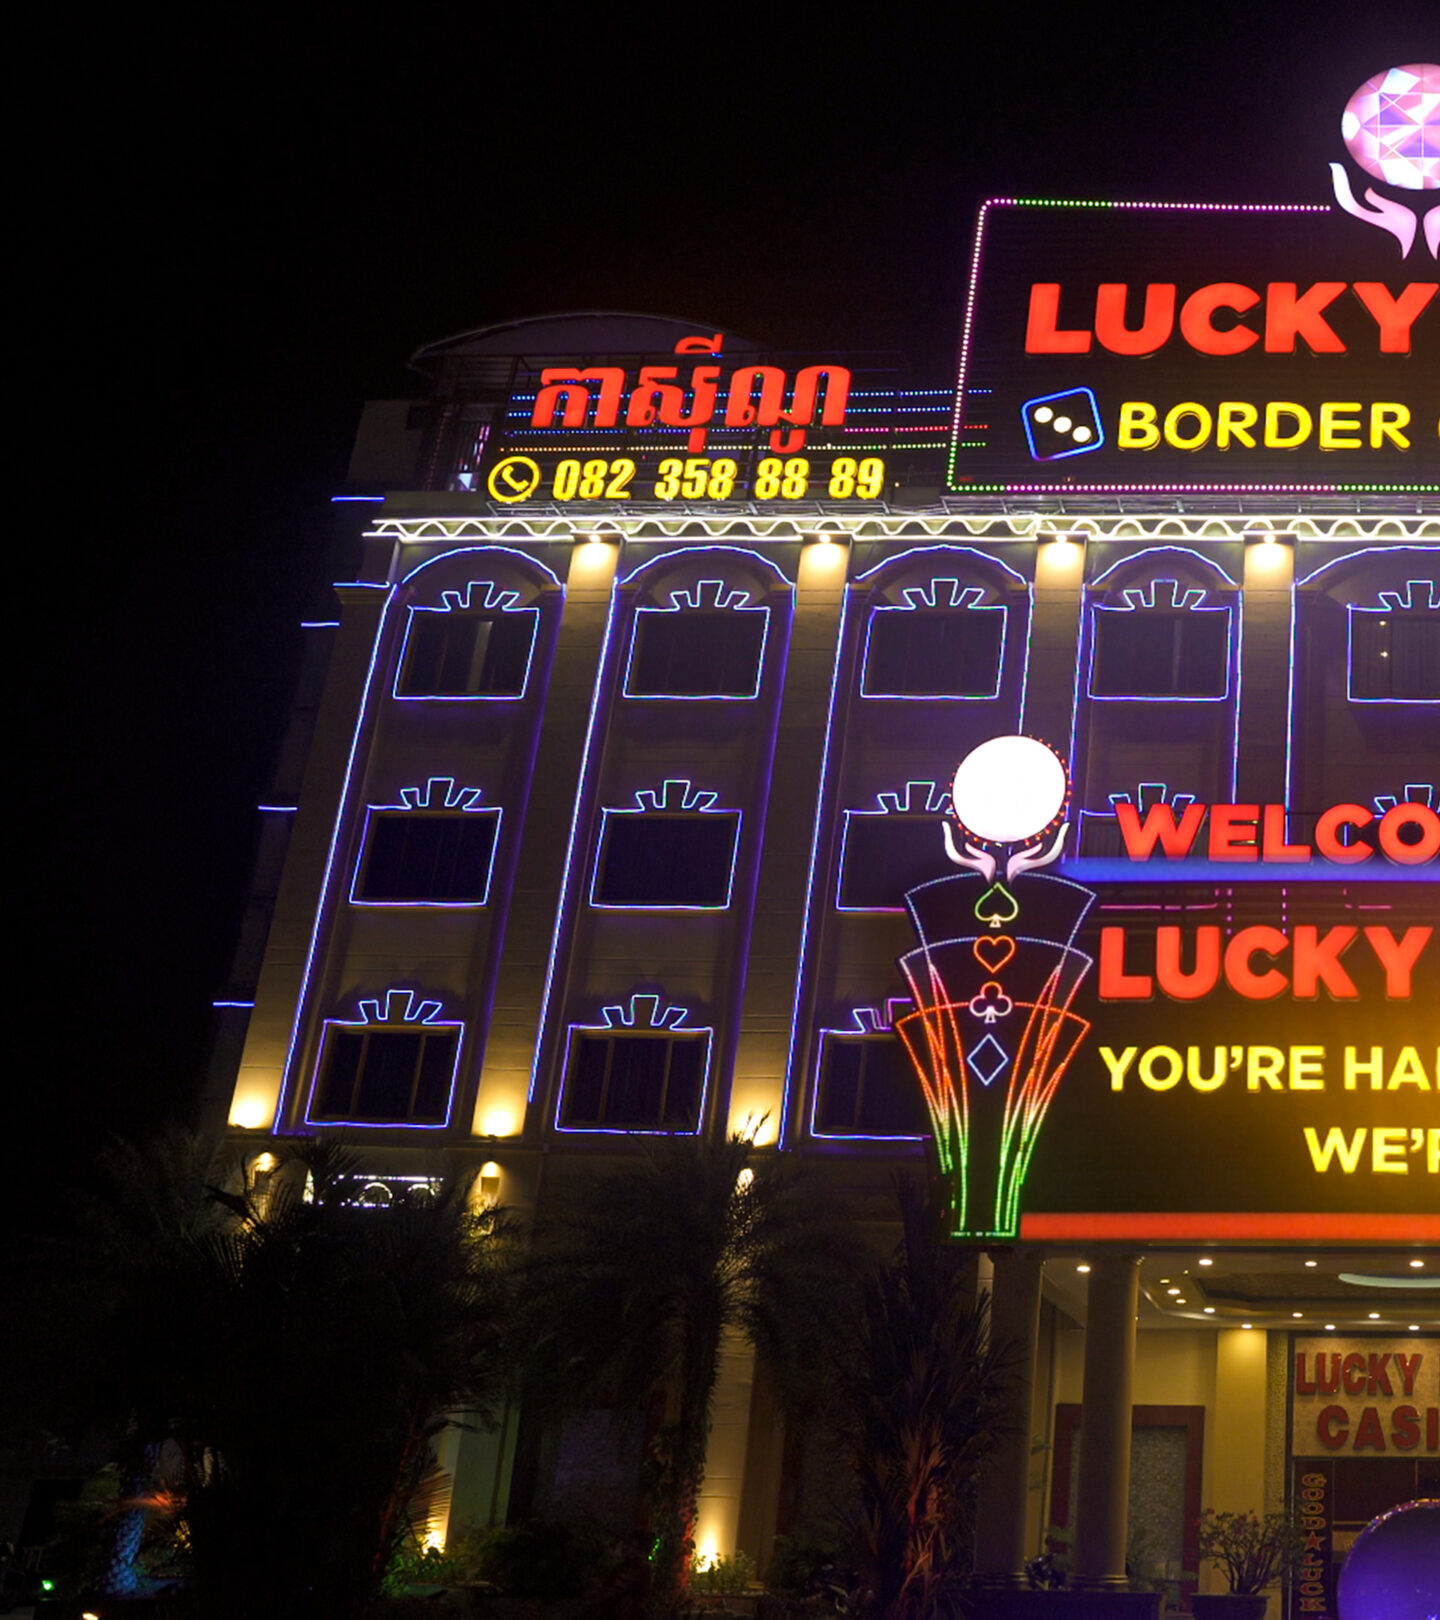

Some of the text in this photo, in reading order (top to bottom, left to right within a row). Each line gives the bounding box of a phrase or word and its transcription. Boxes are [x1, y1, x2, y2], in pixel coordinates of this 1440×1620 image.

[1026, 282, 1439, 355] LUCKY
[1118, 402, 1410, 450] BORDER
[553, 458, 884, 501] 082 358 88 89
[1099, 925, 1433, 1000] LUCKY
[1099, 1046, 1325, 1091] YOU'RE
[1296, 1352, 1423, 1396] LUCKY
[1300, 1473, 1326, 1611] GOOD LUCK
